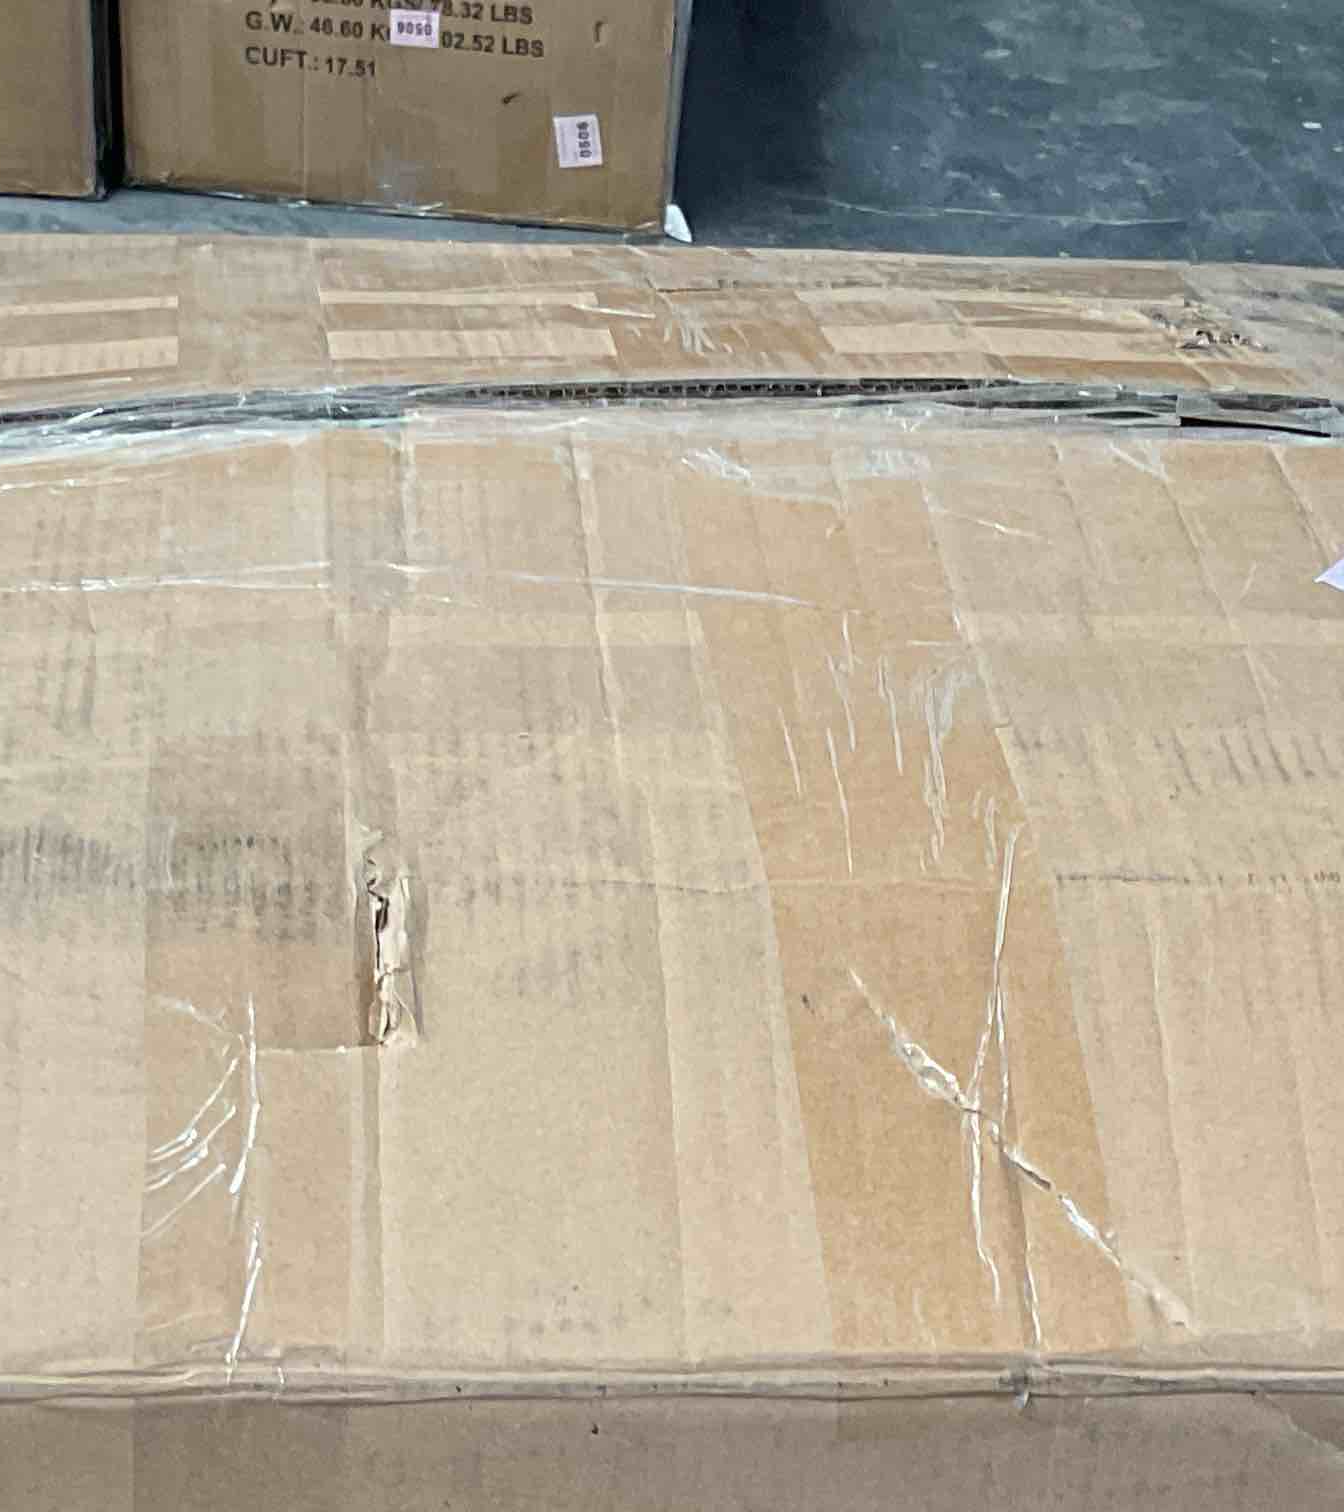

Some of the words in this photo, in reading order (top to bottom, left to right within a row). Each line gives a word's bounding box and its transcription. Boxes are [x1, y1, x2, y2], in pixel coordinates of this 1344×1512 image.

[490, 4, 533, 24] LBS
[501, 35, 545, 57] LBS
[325, 57, 375, 77] 17.51
